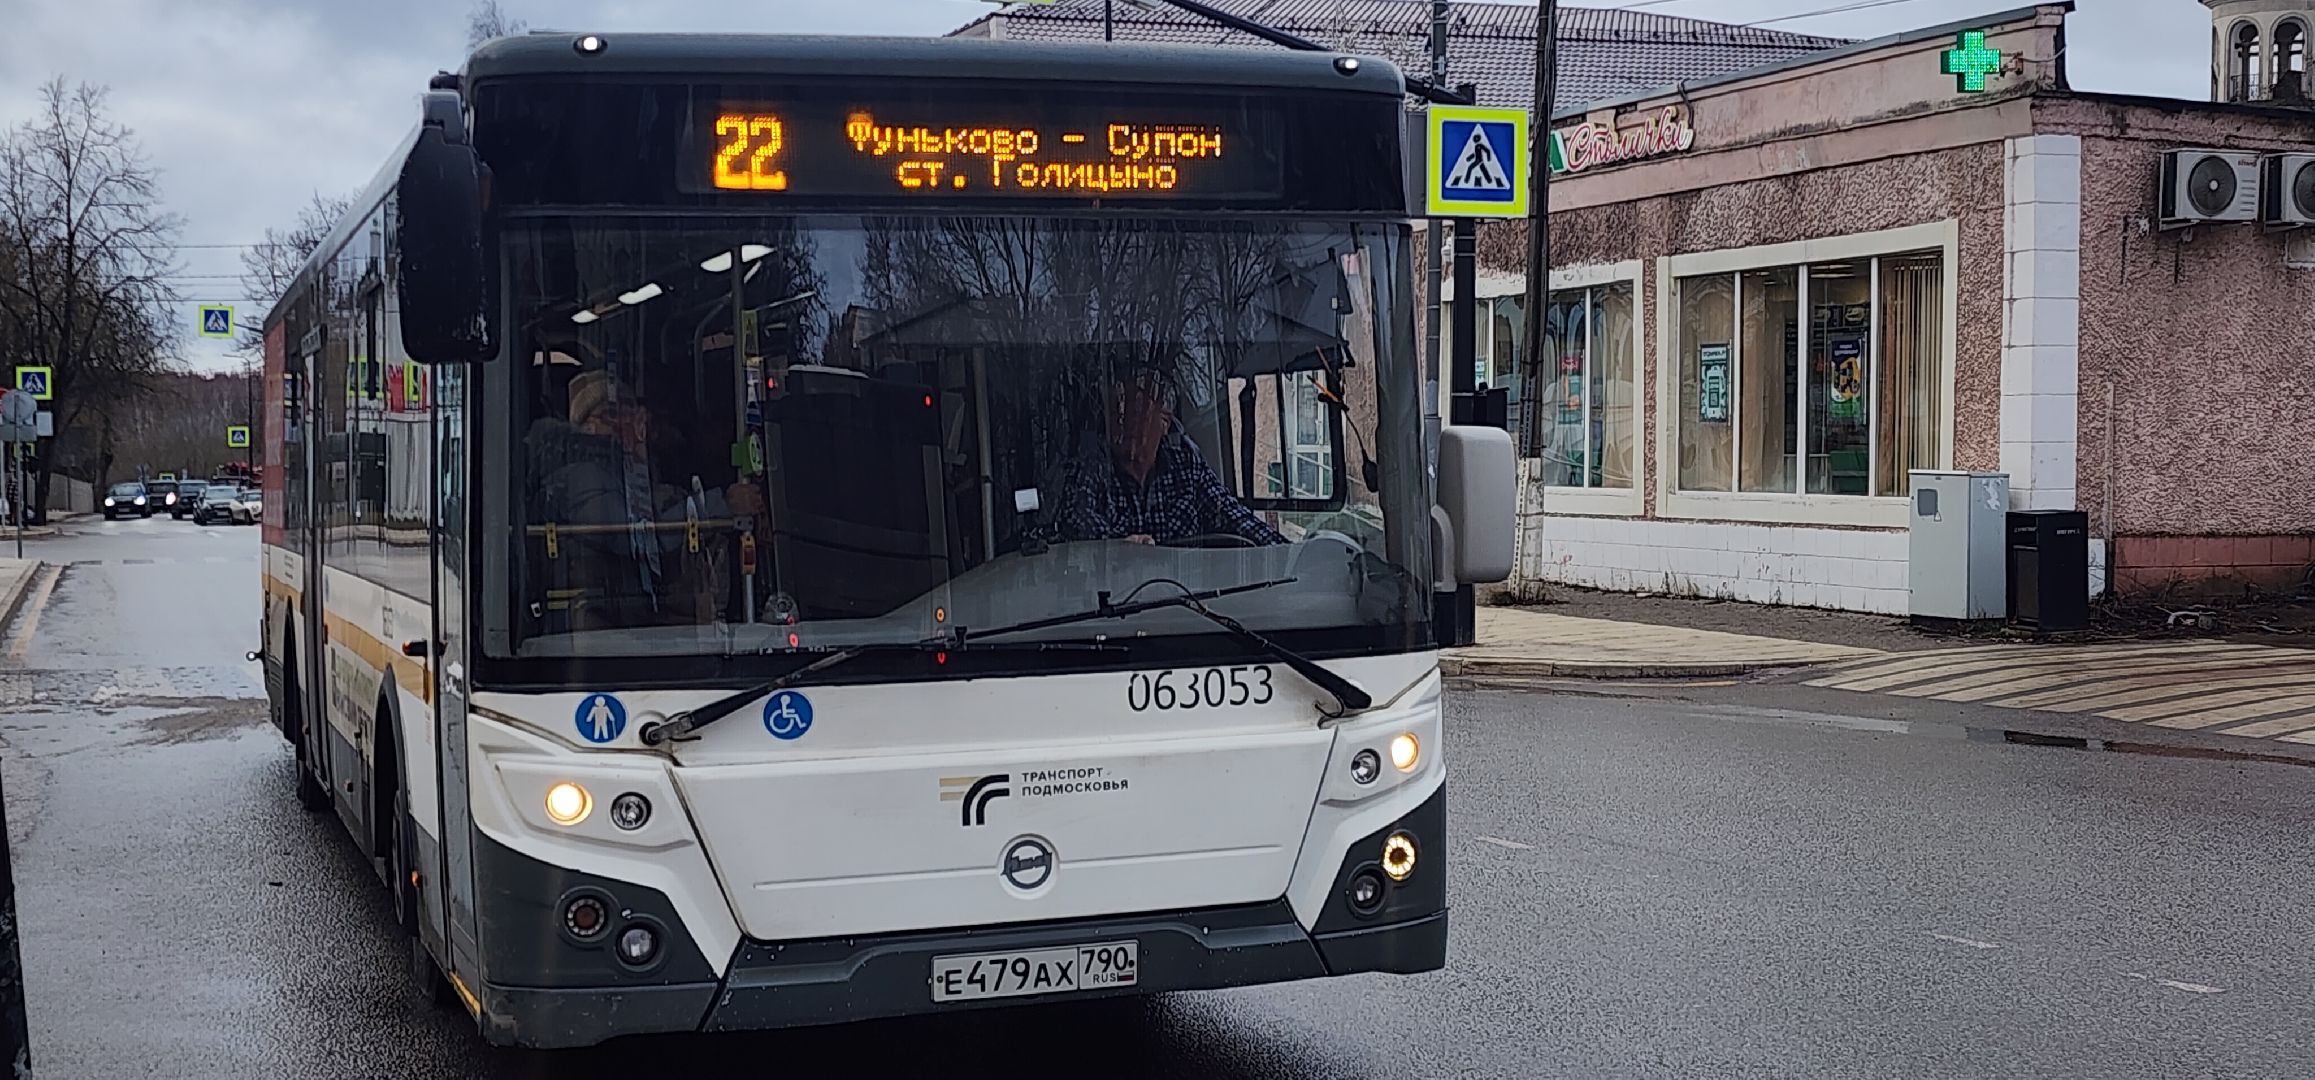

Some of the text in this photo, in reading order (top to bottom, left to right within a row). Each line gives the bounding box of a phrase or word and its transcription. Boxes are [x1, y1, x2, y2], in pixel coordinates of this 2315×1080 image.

[714, 115, 788, 190] 22
[848, 112, 1039, 156] Фуньково
[1109, 123, 1222, 160] Супон
[1567, 105, 1694, 172] Столички
[898, 152, 1178, 192] ст. Голицыно
[1127, 664, 1274, 713] 063053
[1021, 767, 1105, 783] ТРАНСПОРТ
[1021, 779, 1129, 797] ПОДМОСКОВЬЯ
[1080, 946, 1129, 975] 790
[1092, 972, 1117, 985] RUS
